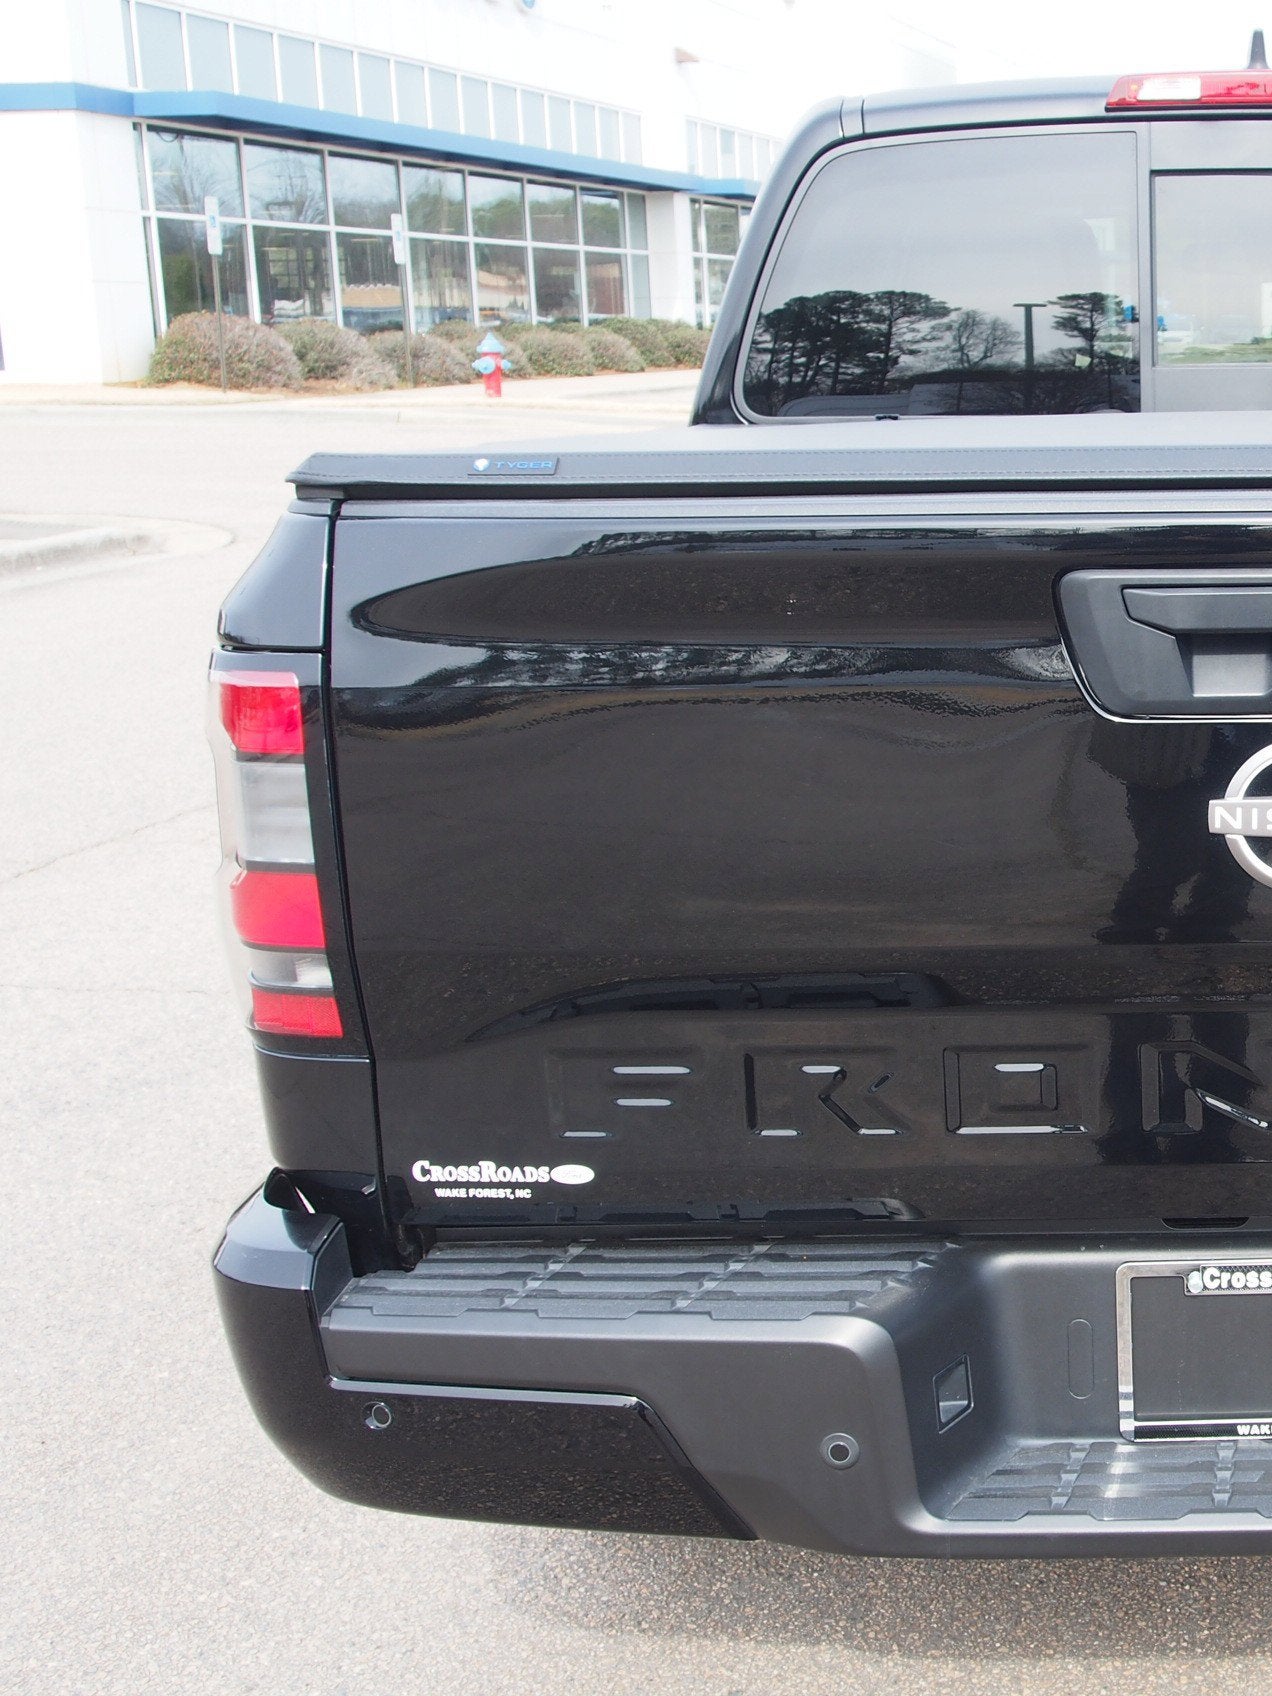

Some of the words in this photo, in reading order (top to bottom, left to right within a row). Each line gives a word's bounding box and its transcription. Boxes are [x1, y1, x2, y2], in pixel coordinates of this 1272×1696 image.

[495, 461, 553, 470] TYGER
[434, 1188, 467, 1198] WAKE
[469, 1188, 514, 1200] FOREST,
[515, 1189, 532, 1198] NC
